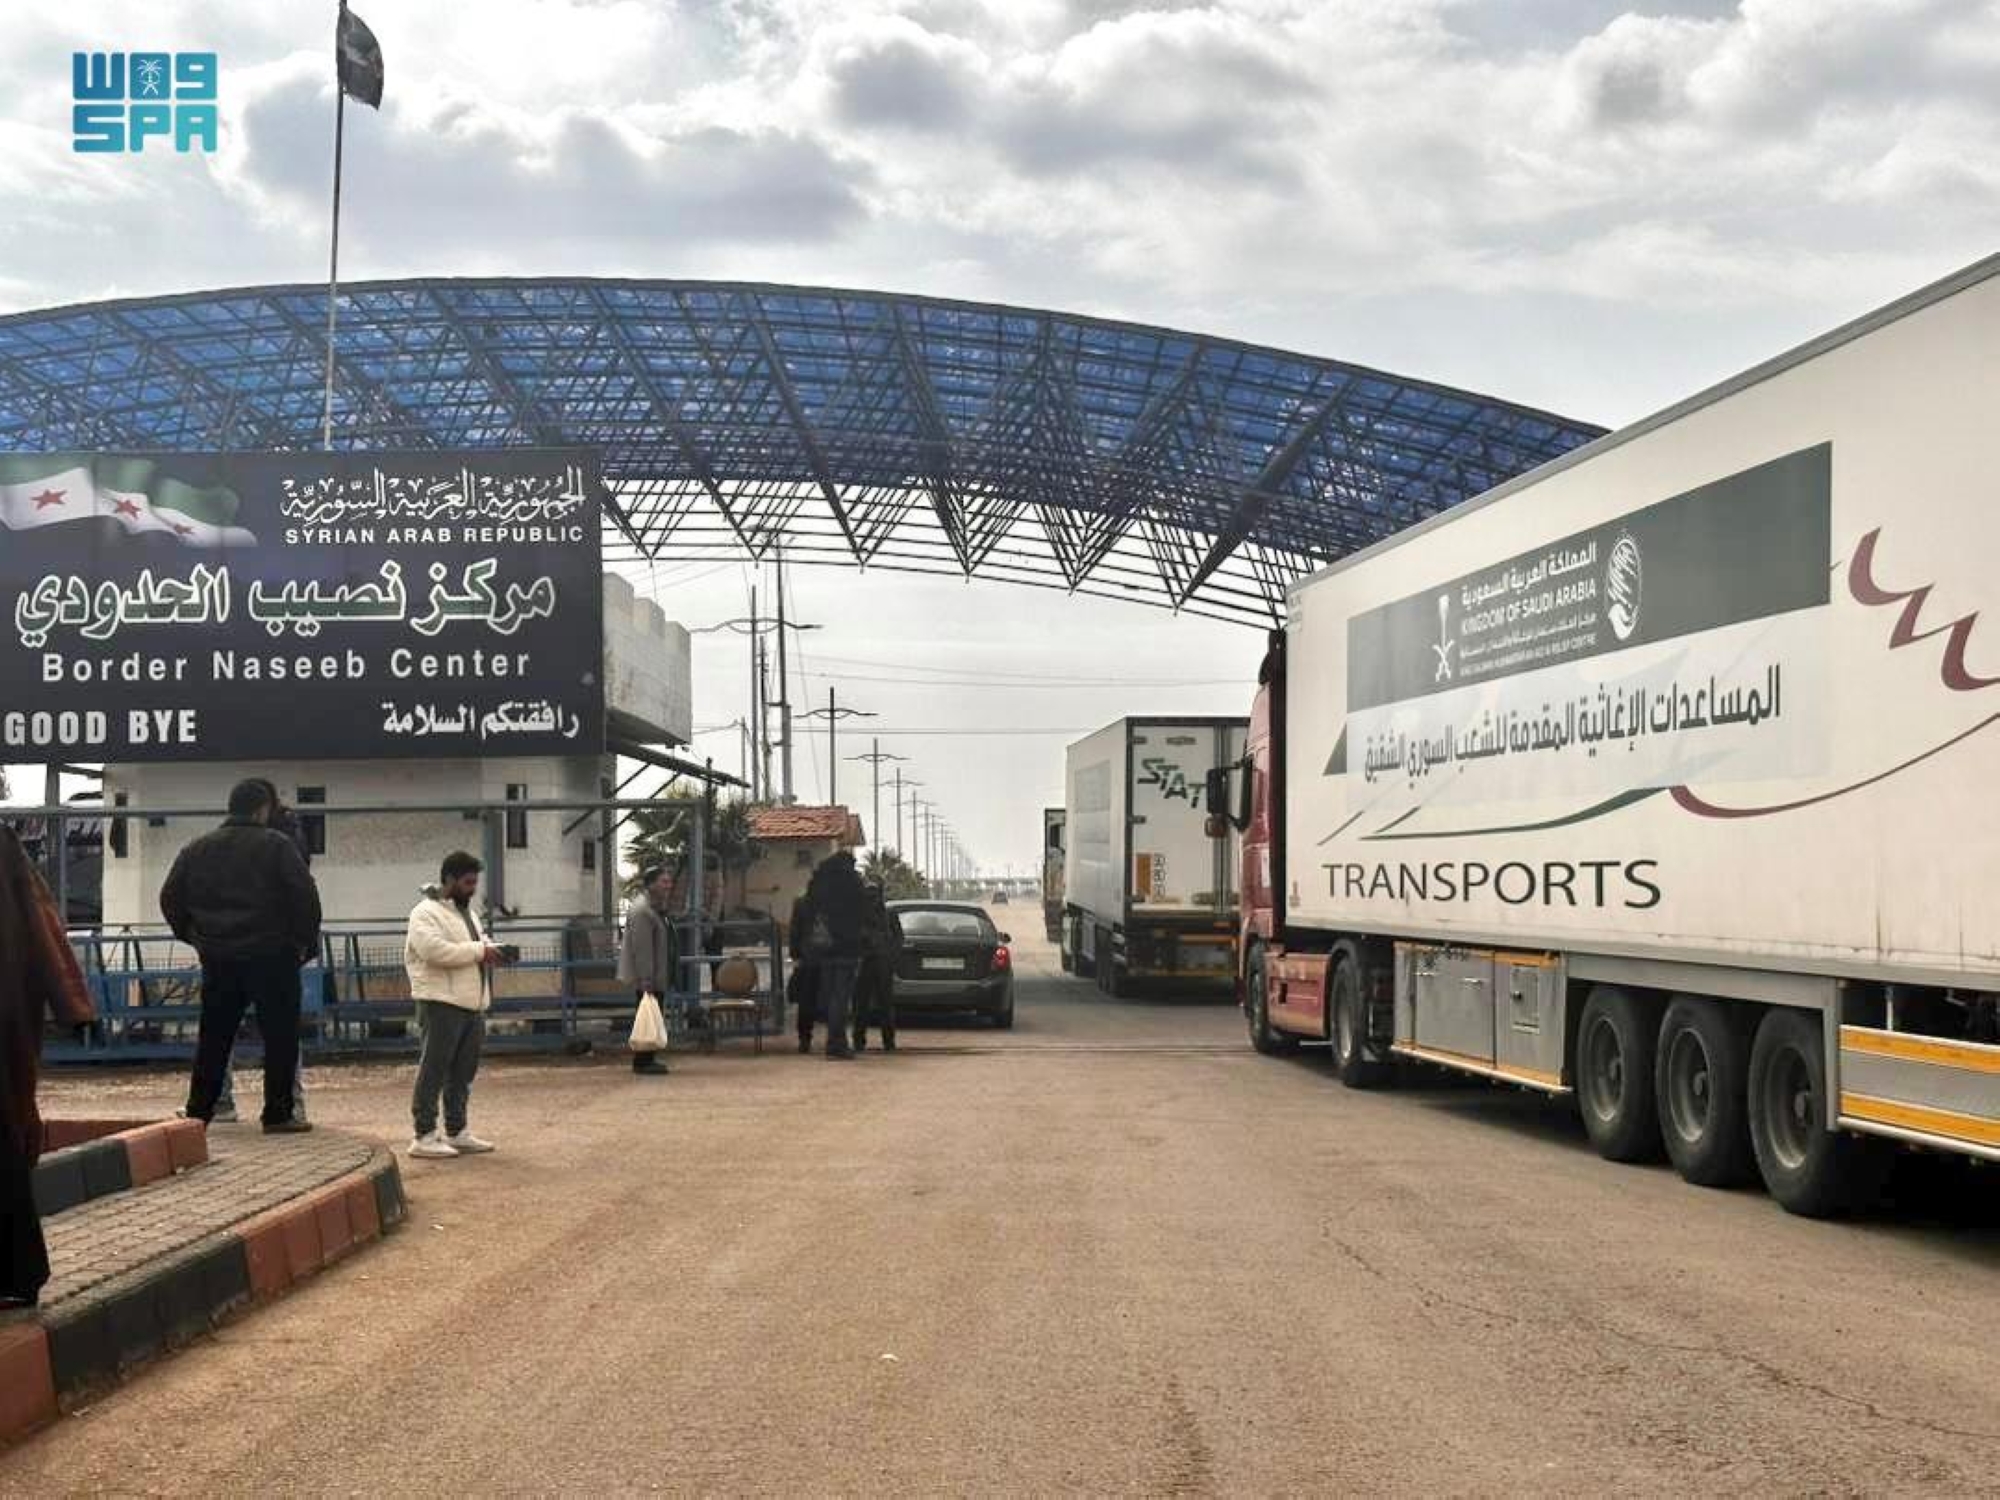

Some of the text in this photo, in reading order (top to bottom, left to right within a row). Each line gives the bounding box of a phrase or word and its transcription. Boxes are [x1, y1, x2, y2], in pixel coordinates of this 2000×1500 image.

[285, 526, 584, 544] SYRIAN ARAB REPUBLIC
[1549, 541, 1598, 576] المملكة
[15, 558, 555, 647] مركز نصيب الحدودي
[1506, 599, 1522, 622] OF
[1522, 588, 1553, 618] SAUDI
[1555, 577, 1597, 606] ARABIA
[42, 648, 530, 682] Border Naseeb Center
[380, 700, 579, 739] رافقتكم السلامة
[1579, 682, 1646, 757] الإغاثية
[1650, 663, 1780, 733] المساعدات
[4, 709, 196, 746] GOOD BYE
[1455, 709, 1508, 774] للشعب
[1510, 701, 1576, 752] المقدمة
[1322, 859, 1662, 909] TRANSPORTS
